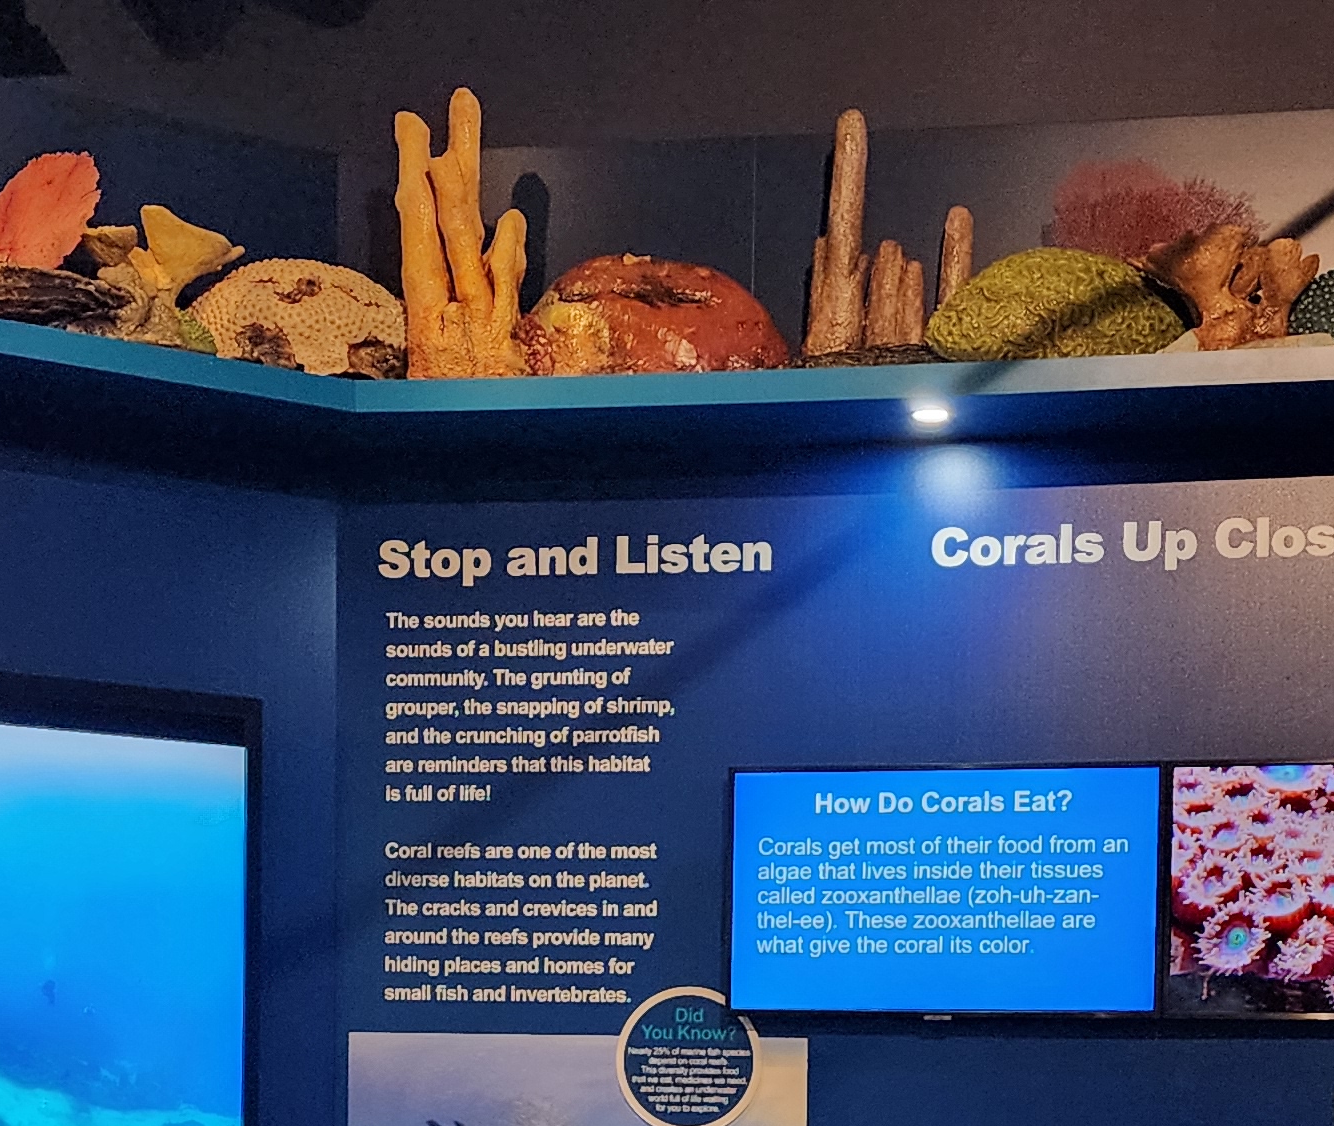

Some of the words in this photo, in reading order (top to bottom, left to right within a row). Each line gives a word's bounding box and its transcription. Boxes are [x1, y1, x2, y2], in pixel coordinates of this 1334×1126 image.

[931, 524, 1104, 567] Corals
[1123, 519, 1198, 571] Up
[378, 540, 492, 587] Stop
[507, 536, 598, 577] and
[616, 534, 772, 574] Listen
[385, 612, 420, 629] The
[423, 611, 490, 629] sounds
[495, 614, 528, 632] you
[533, 610, 574, 627] hear
[577, 613, 606, 627] are
[610, 609, 640, 626] the
[386, 640, 452, 658] sounds
[457, 640, 476, 657] of
[479, 644, 490, 657] a
[494, 639, 566, 660] bustling
[571, 638, 674, 656] underwater
[386, 669, 488, 690] community.
[493, 669, 526, 686] The
[531, 668, 607, 690] grunting
[611, 667, 632, 685] of
[385, 702, 459, 720] grouper,
[463, 698, 492, 715] the
[496, 697, 580, 719] snapping
[584, 697, 604, 714] of
[607, 697, 675, 717] shrimp,
[385, 727, 418, 744] and
[423, 727, 452, 744] the
[455, 727, 546, 747] crunching
[549, 726, 570, 744] of
[573, 725, 660, 747] parrotfish
[385, 760, 414, 773] are
[418, 756, 508, 773] reminders
[511, 756, 546, 772] that
[550, 755, 584, 772] this
[589, 755, 650, 772] habitat
[385, 785, 401, 801] is
[405, 785, 432, 802] full
[437, 785, 456, 802] of
[459, 785, 491, 801] life!
[815, 793, 870, 814] How
[879, 792, 913, 813] Do
[921, 791, 1004, 813] Corals
[1014, 790, 1072, 812] Eat?
[385, 842, 432, 859] Coral
[437, 843, 480, 859] reefs
[485, 846, 514, 859] are
[517, 846, 552, 859] one
[555, 842, 575, 859] of
[577, 842, 606, 859] the
[611, 843, 657, 859] most
[759, 837, 822, 855] Corals
[829, 838, 860, 860] get
[867, 838, 915, 854] most
[921, 836, 942, 854] of
[947, 836, 992, 854] their
[998, 835, 1042, 854] food
[1049, 835, 1096, 853] from
[1103, 839, 1128, 853] an
[385, 871, 450, 887] diverse
[454, 871, 524, 888] habitats
[529, 875, 552, 888] on
[555, 871, 585, 888] the
[589, 871, 649, 892] planet.
[758, 862, 812, 884] algae
[818, 862, 856, 880] that
[862, 862, 907, 879] lives
[914, 861, 972, 879] inside
[980, 861, 1025, 879] their
[1031, 861, 1103, 878] tissues
[757, 887, 815, 904] called
[821, 886, 960, 904] zooxanthellae
[968, 885, 1099, 908] (zoh-uh-zan-
[757, 911, 837, 933] thel-ee).
[845, 911, 907, 928] These
[913, 911, 1055, 929] zooxanthellae
[1062, 915, 1095, 928] are
[757, 936, 804, 954] what
[809, 936, 850, 958] give
[857, 936, 888, 953] the
[894, 936, 943, 954] coral
[950, 936, 972, 953] its
[979, 936, 1035, 954] color.
[675, 1007, 704, 1022] Did
[641, 1024, 673, 1039] You
[678, 1025, 737, 1041] Know?
